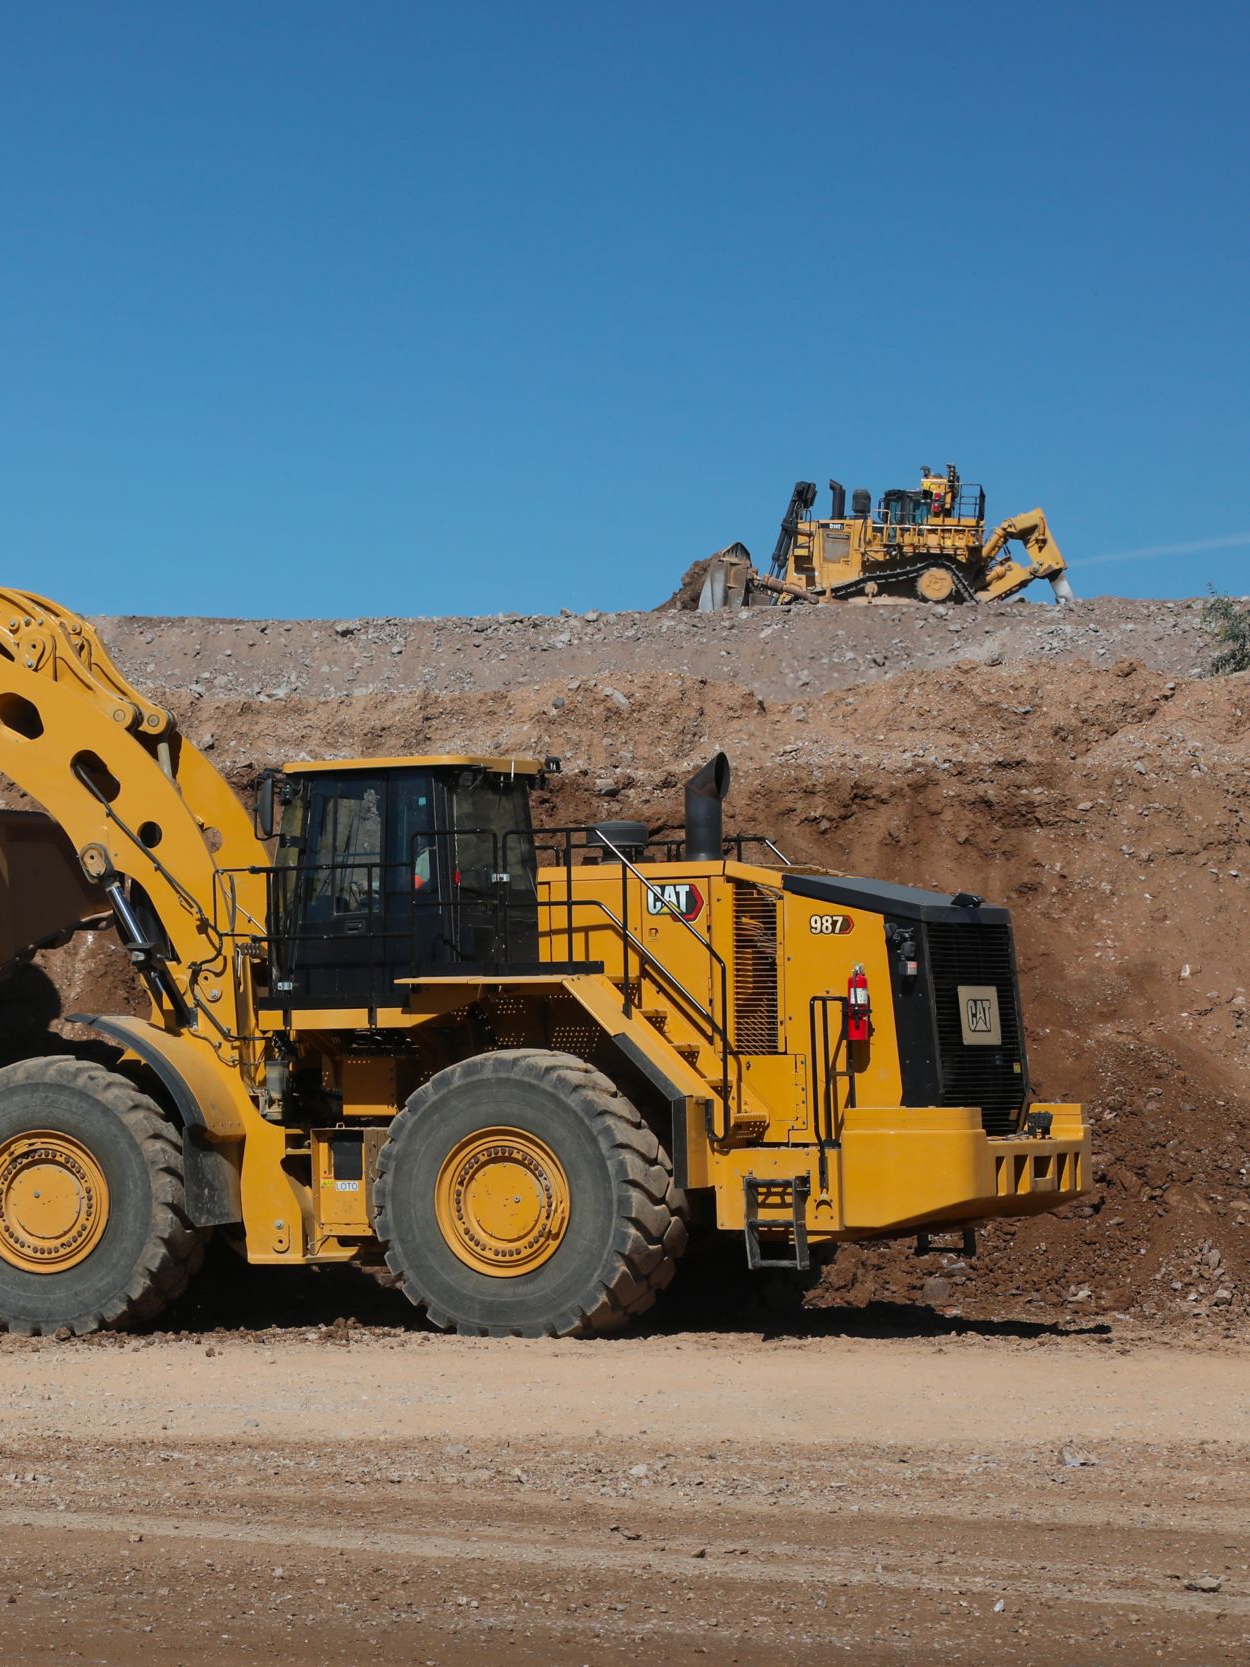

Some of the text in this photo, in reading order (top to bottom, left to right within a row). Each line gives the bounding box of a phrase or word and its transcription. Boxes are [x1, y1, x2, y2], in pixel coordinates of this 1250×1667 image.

[647, 885, 690, 915] CAT
[810, 915, 843, 934] 987
[967, 999, 991, 1032] CAT
